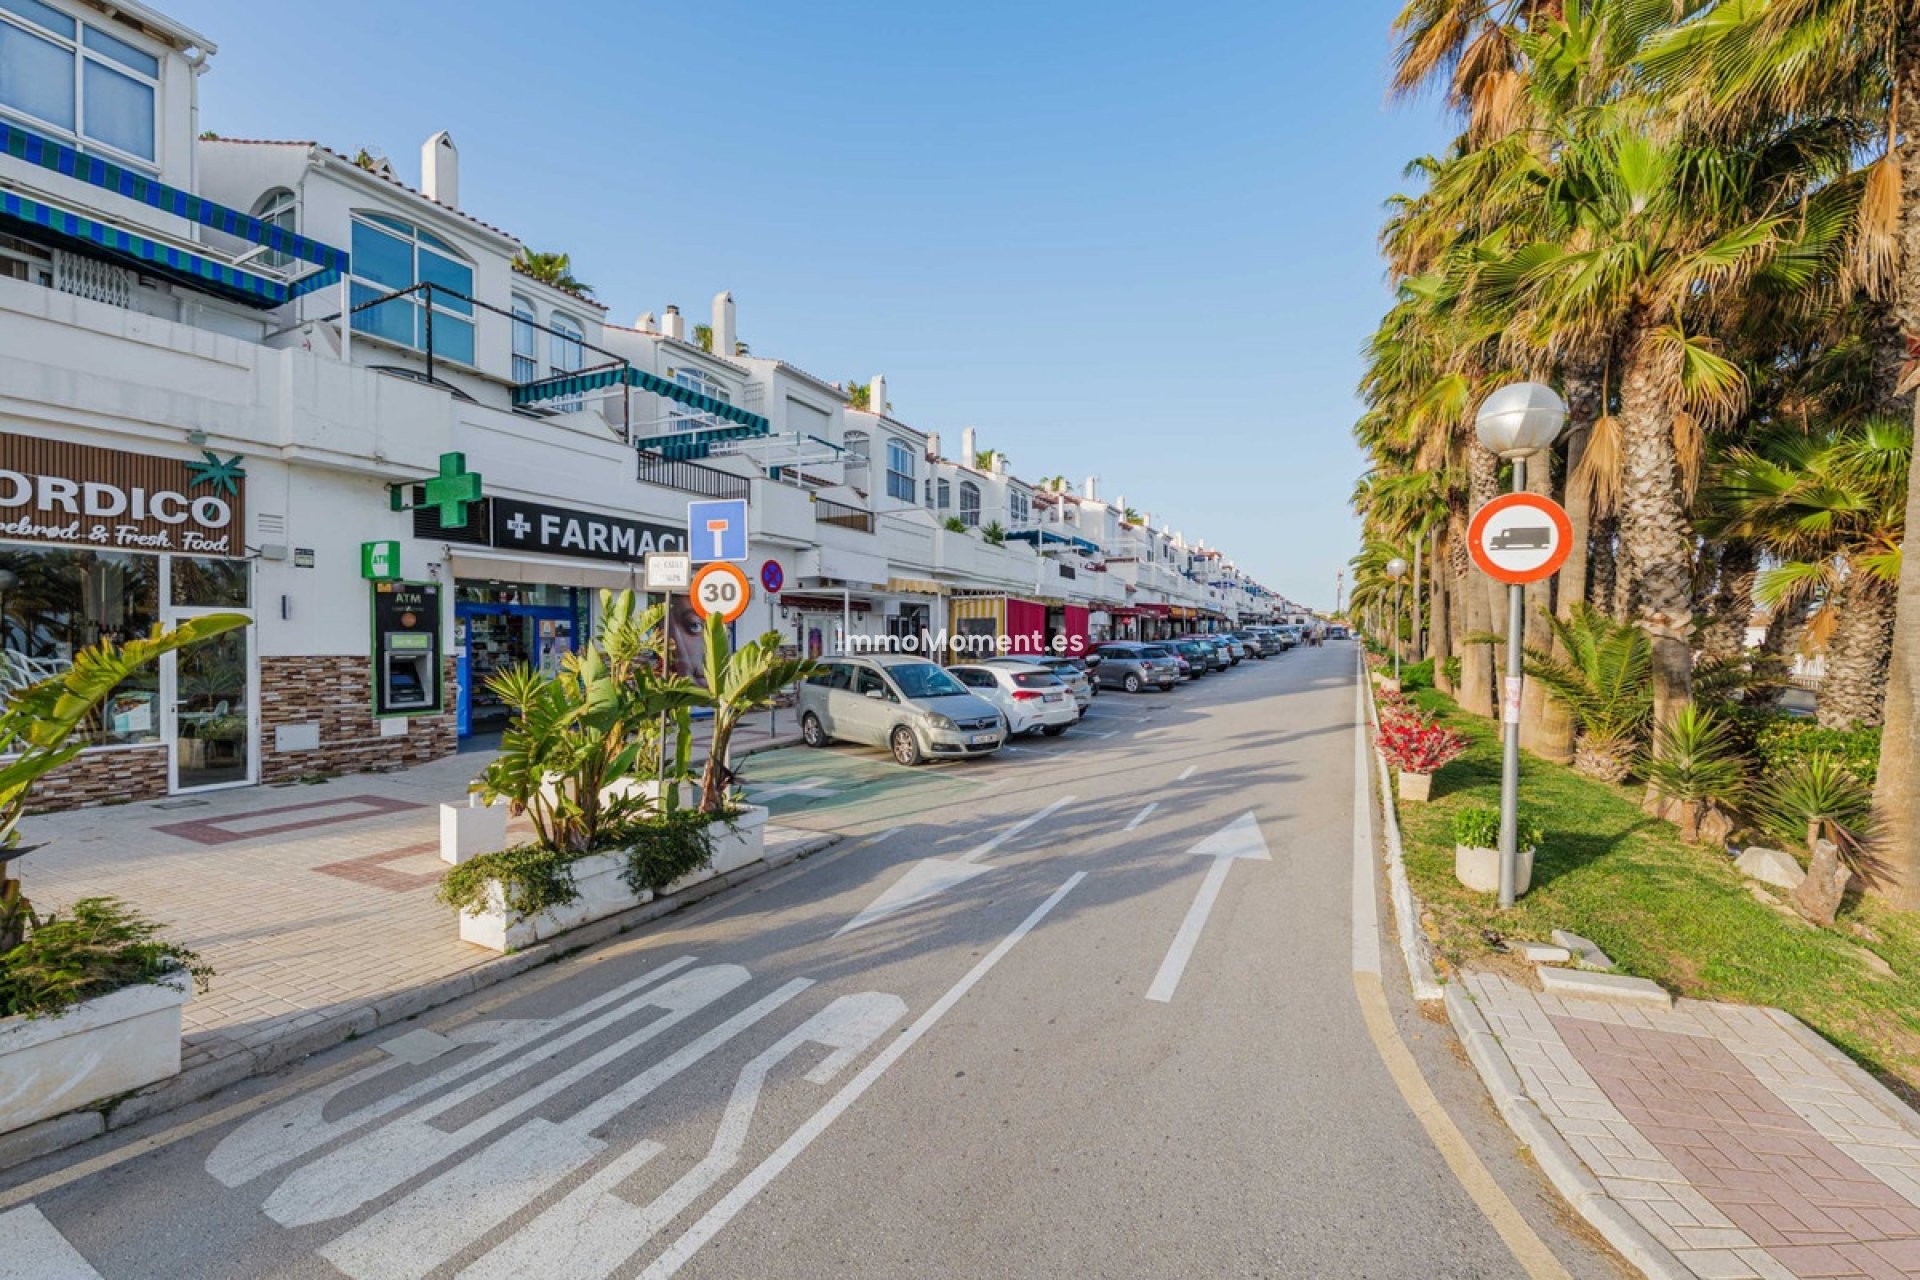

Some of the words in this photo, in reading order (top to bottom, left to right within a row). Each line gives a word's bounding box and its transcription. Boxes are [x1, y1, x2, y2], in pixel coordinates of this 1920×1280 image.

[88, 524, 109, 543] &
[114, 525, 172, 548] Fresh
[181, 531, 229, 552] Food
[395, 593, 421, 603] ATM
[703, 583, 736, 602] 30
